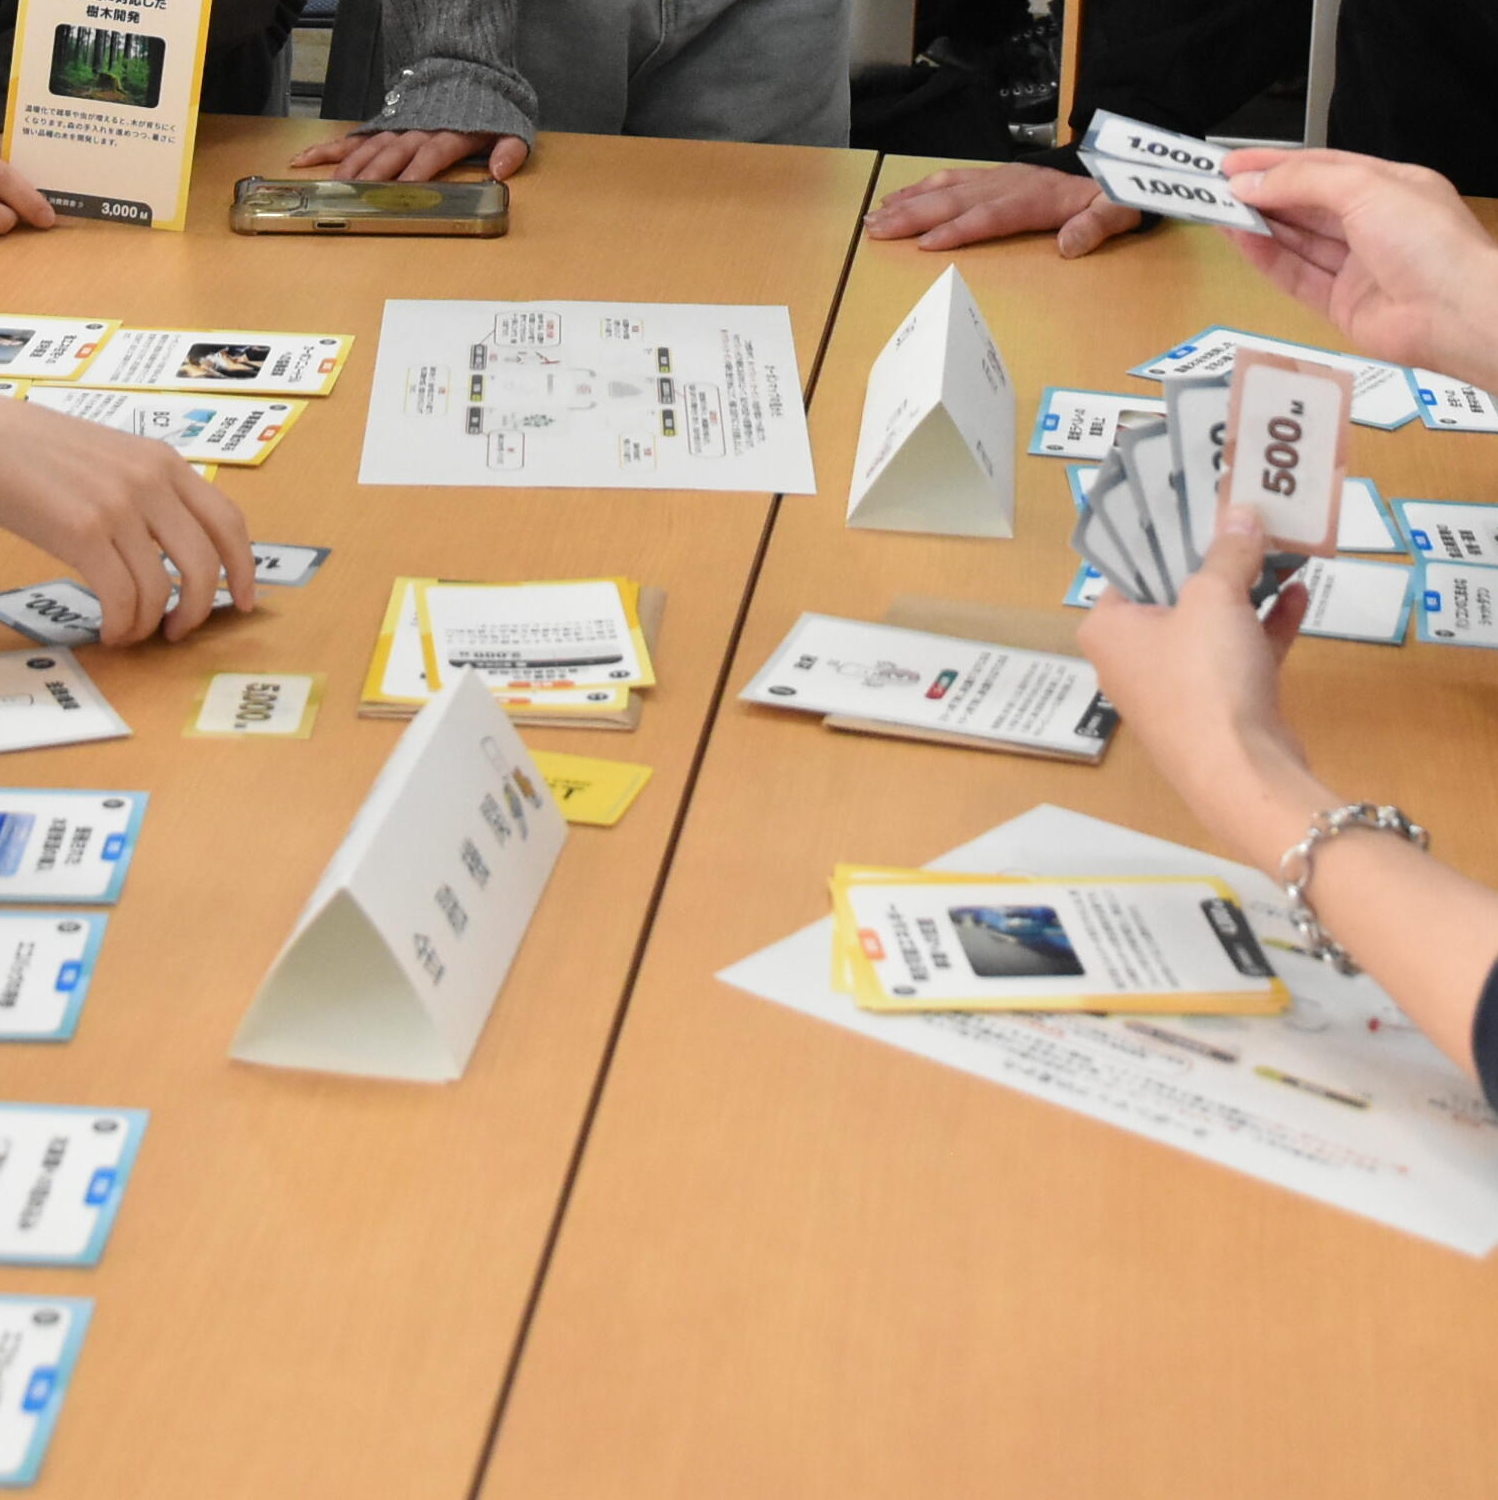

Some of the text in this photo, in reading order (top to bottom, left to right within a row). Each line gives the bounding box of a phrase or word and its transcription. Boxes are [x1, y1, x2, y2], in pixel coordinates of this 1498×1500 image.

[86, 4, 141, 24] 樹木開発
[1129, 174, 1218, 205] 1,000
[101, 202, 138, 218] 3,000
[1262, 416, 1303, 498] 500
